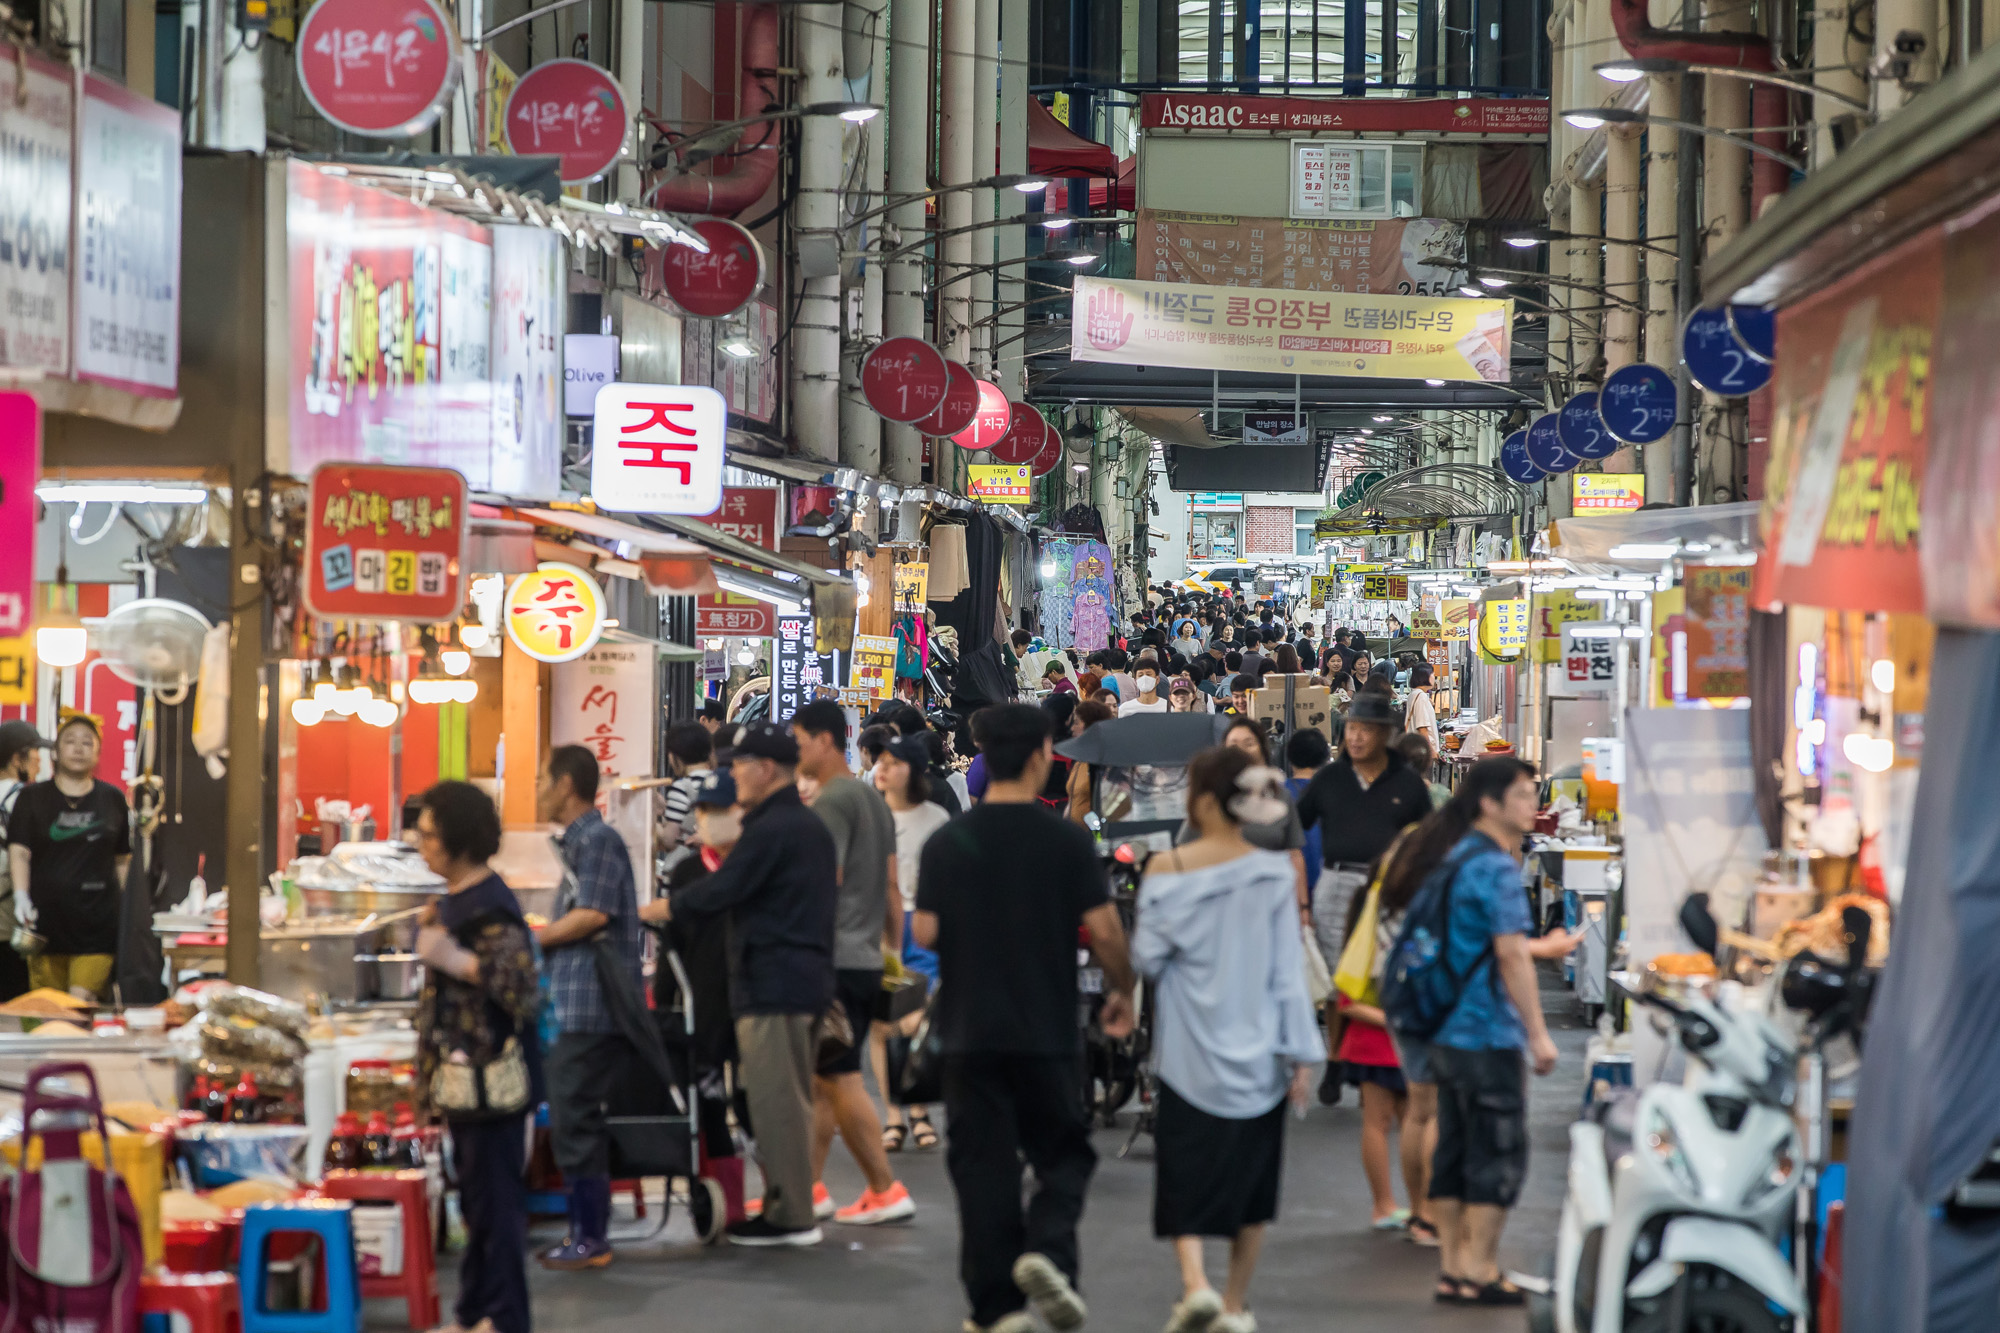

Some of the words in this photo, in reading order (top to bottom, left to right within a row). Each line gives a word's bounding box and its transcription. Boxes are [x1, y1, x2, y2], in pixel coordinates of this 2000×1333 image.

[1161, 97, 1243, 126] Asaac
[1249, 113, 1280, 124] 토스트
[1291, 113, 1342, 126] 생과일쥬스
[1335, 163, 1351, 171] 라면
[1336, 173, 1350, 181] 커피
[1329, 233, 1372, 245] 바나나
[1329, 246, 1371, 257] 토마토
[564, 368, 605, 381] Olive
[1722, 350, 1745, 385] 2
[897, 385, 908, 414] 1
[915, 385, 940, 400] 지구
[950, 402, 973, 415] 지구
[984, 417, 1005, 430] 지구
[1630, 408, 1649, 436] 2
[618, 402, 698, 485] 죽
[1010, 436, 1017, 458] 1
[1022, 436, 1040, 448] 지구
[1583, 428, 1600, 452] 2
[1550, 446, 1565, 467] 2
[1019, 468, 1026, 477] 6
[1521, 460, 1534, 479] 2
[1581, 477, 1588, 486] 2
[325, 551, 442, 593] 꼬마김밥
[1365, 577, 1386, 597] 구운
[1388, 578, 1407, 597] 마늘
[1498, 614, 1525, 624] 고추
[856, 638, 896, 652] 납작만두
[858, 653, 882, 665] 1,500
[781, 659, 798, 689] 만든
[1567, 656, 1615, 681] 반찬
